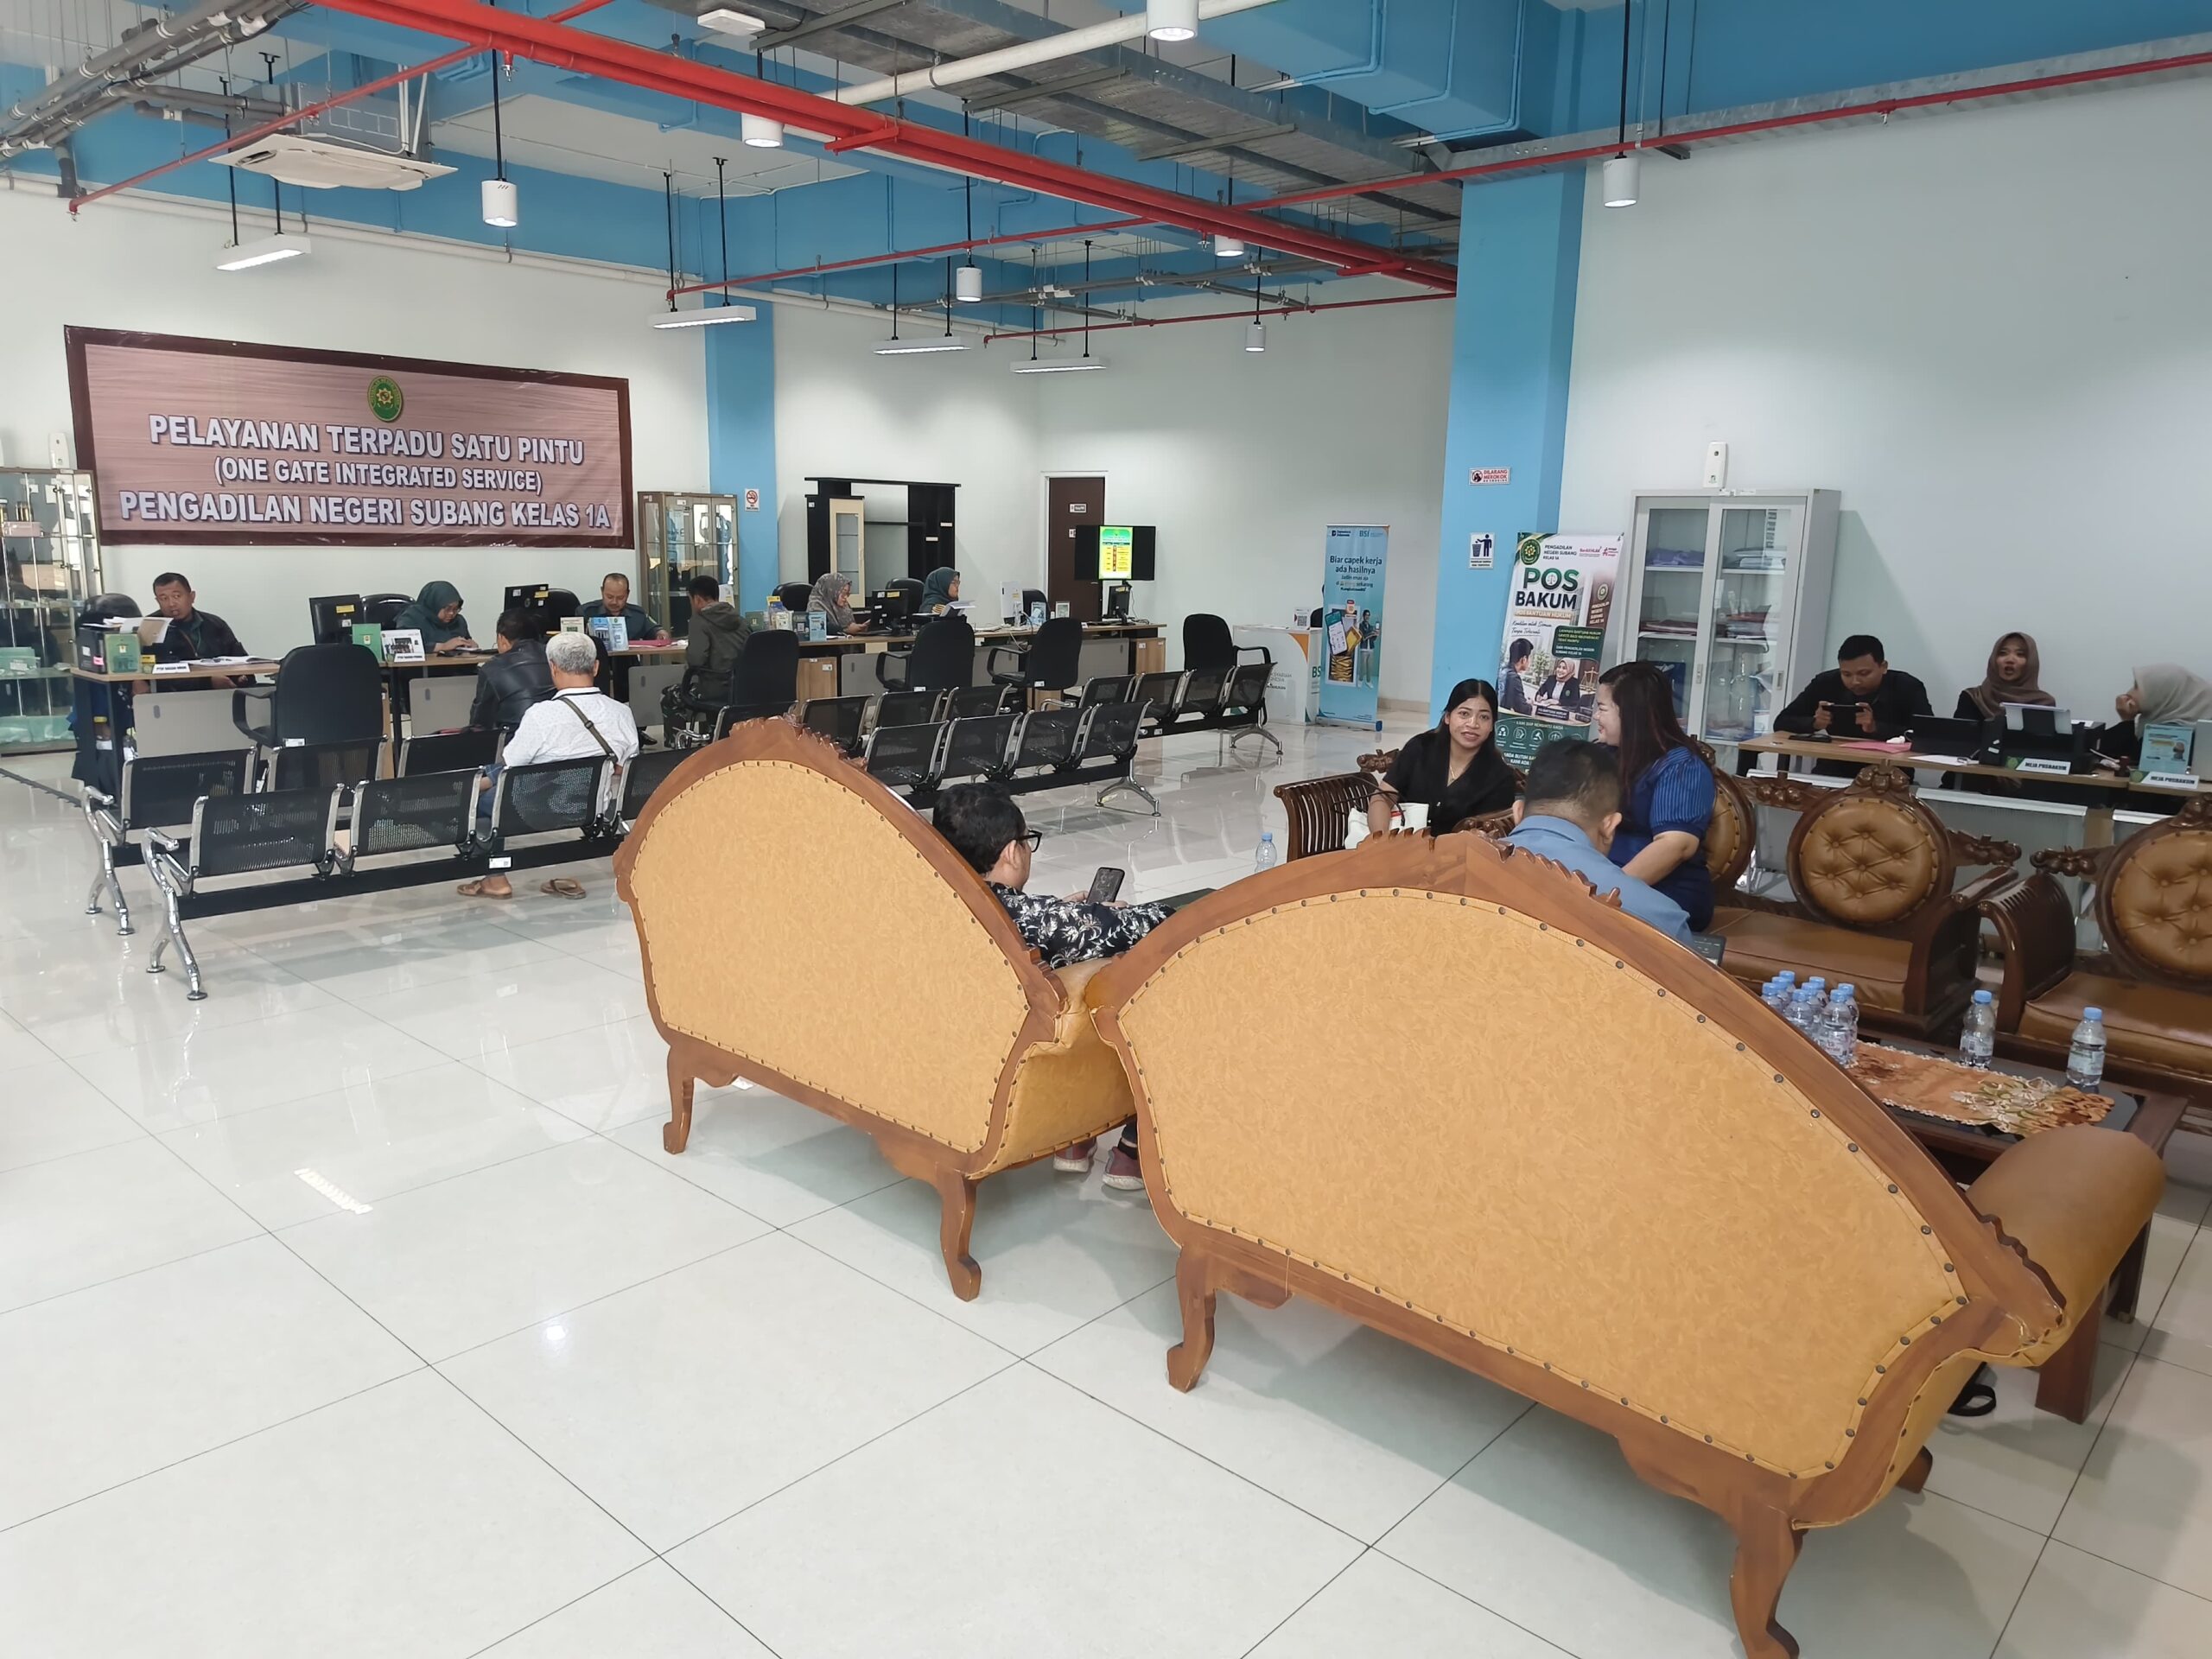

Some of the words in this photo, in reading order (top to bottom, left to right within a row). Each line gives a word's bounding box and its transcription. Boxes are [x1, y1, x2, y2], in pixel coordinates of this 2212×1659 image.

[149, 414, 320, 452] PELAYANAN
[326, 424, 443, 457] TERPADU
[450, 432, 511, 461] SATU
[518, 436, 584, 465] PINTU
[215, 456, 269, 486] (ONE
[274, 459, 330, 484] GATE
[335, 462, 457, 488] INTEGRATED
[461, 467, 543, 495] SERVICE)
[119, 491, 302, 523] PENGADILAN
[309, 496, 403, 524] NEGERI
[410, 499, 505, 525] SUBANG
[512, 501, 580, 527] KELAS
[586, 504, 611, 528] 1A
[1344, 556, 1364, 565] capek
[1365, 556, 1382, 566] kerja
[1349, 565, 1376, 575] hasilnya
[1523, 568, 1580, 591] POS
[1515, 591, 1577, 609] BAKUM
[1313, 666, 1321, 678] BS
